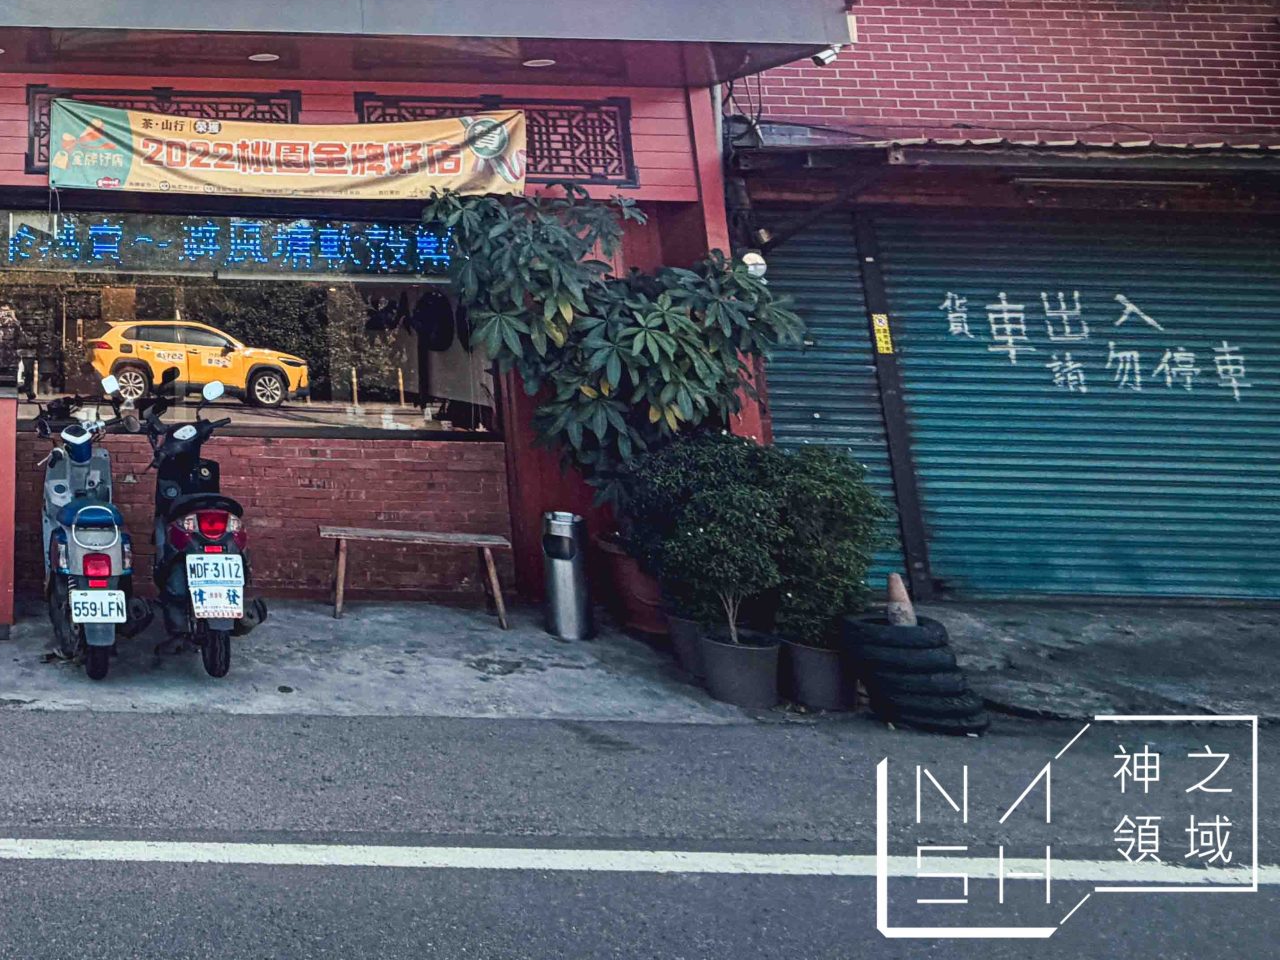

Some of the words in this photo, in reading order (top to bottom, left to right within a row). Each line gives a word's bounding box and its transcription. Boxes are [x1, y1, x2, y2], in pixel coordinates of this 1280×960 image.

[141, 138, 463, 176] 2022桃園金牌好店
[1045, 340, 1252, 403] 請勿停車
[189, 562, 242, 579] MDF-3112
[73, 601, 125, 617] 559-LFN
